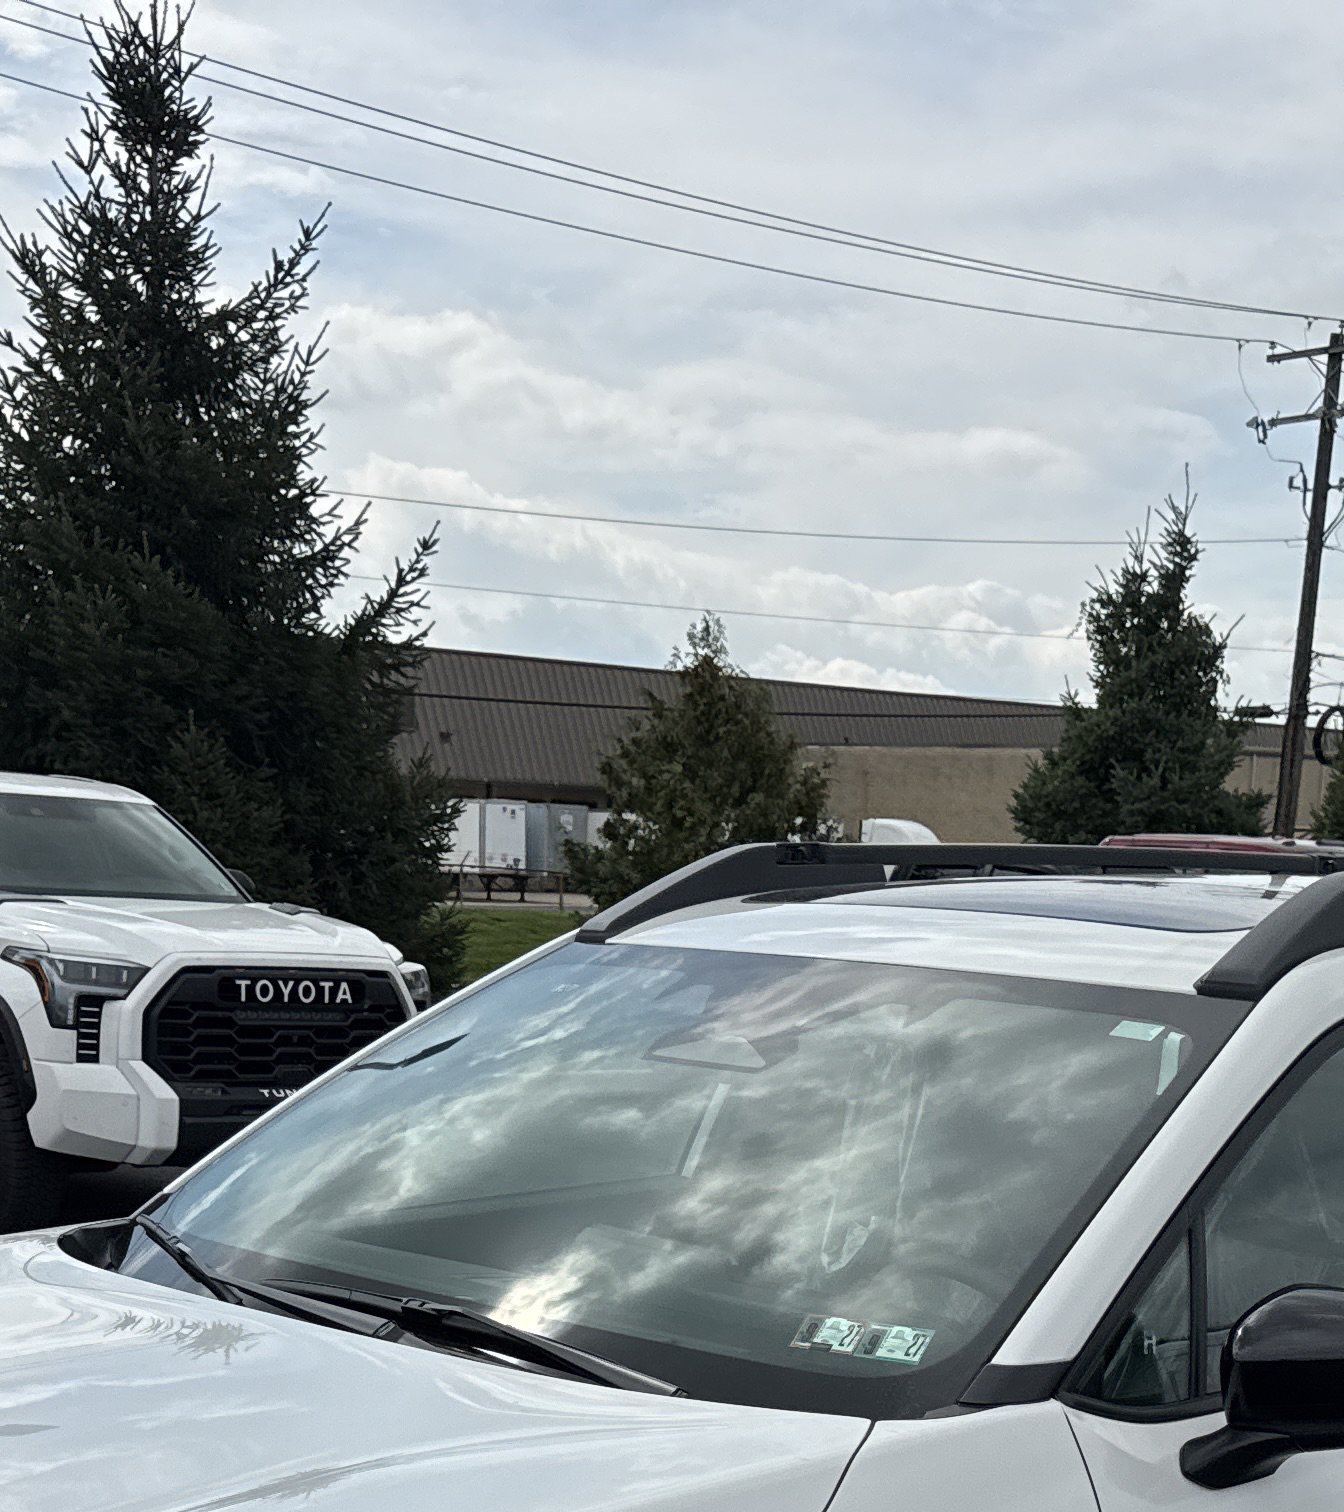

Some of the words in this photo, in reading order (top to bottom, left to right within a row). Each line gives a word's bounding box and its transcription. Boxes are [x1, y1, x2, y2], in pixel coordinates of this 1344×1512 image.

[235, 979, 353, 1004] TOYOTA
[258, 1088, 297, 1098] TUN
[903, 1332, 929, 1358] 27
